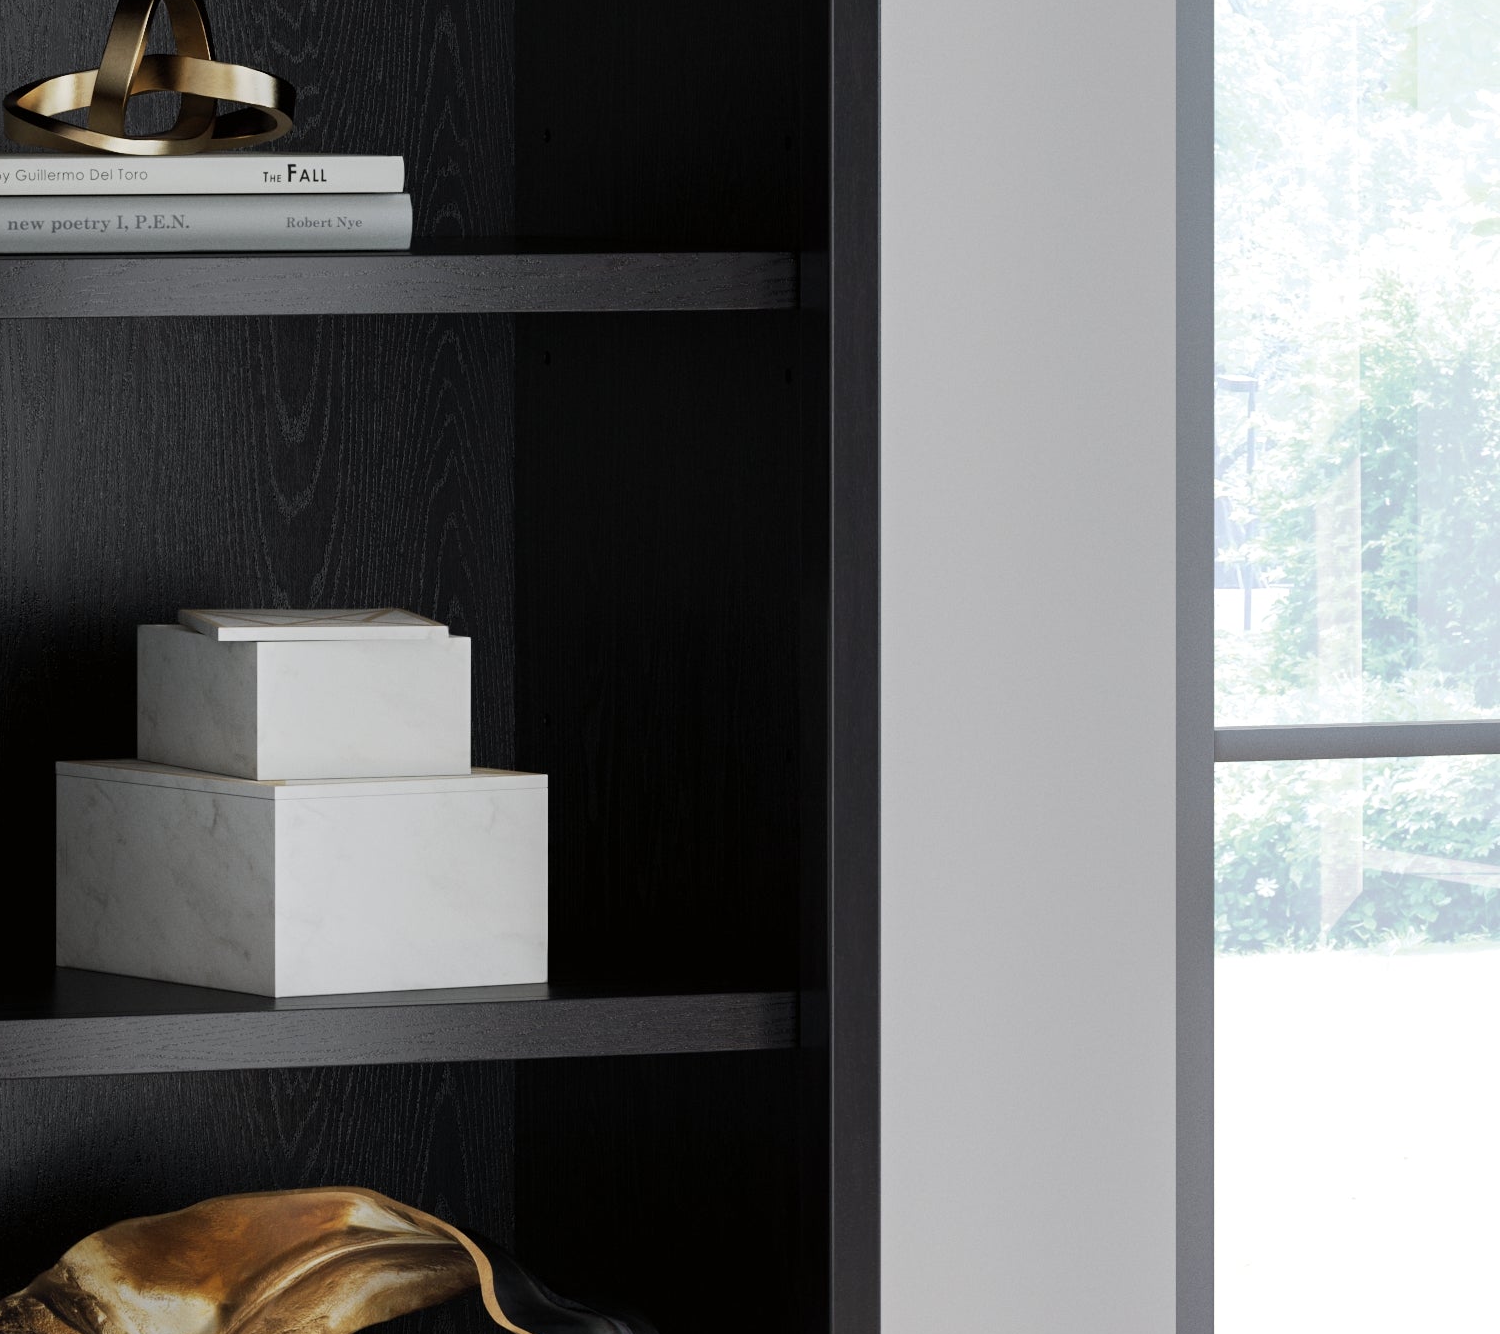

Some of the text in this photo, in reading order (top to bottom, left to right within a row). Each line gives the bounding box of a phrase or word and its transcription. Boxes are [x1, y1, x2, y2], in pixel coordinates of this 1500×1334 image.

[15, 169, 85, 181] Guillermo
[90, 168, 113, 181] Del
[118, 168, 148, 181] Toro
[7, 214, 190, 234] new poetry I, P.E.N.
[286, 217, 363, 230] Robert Nye
